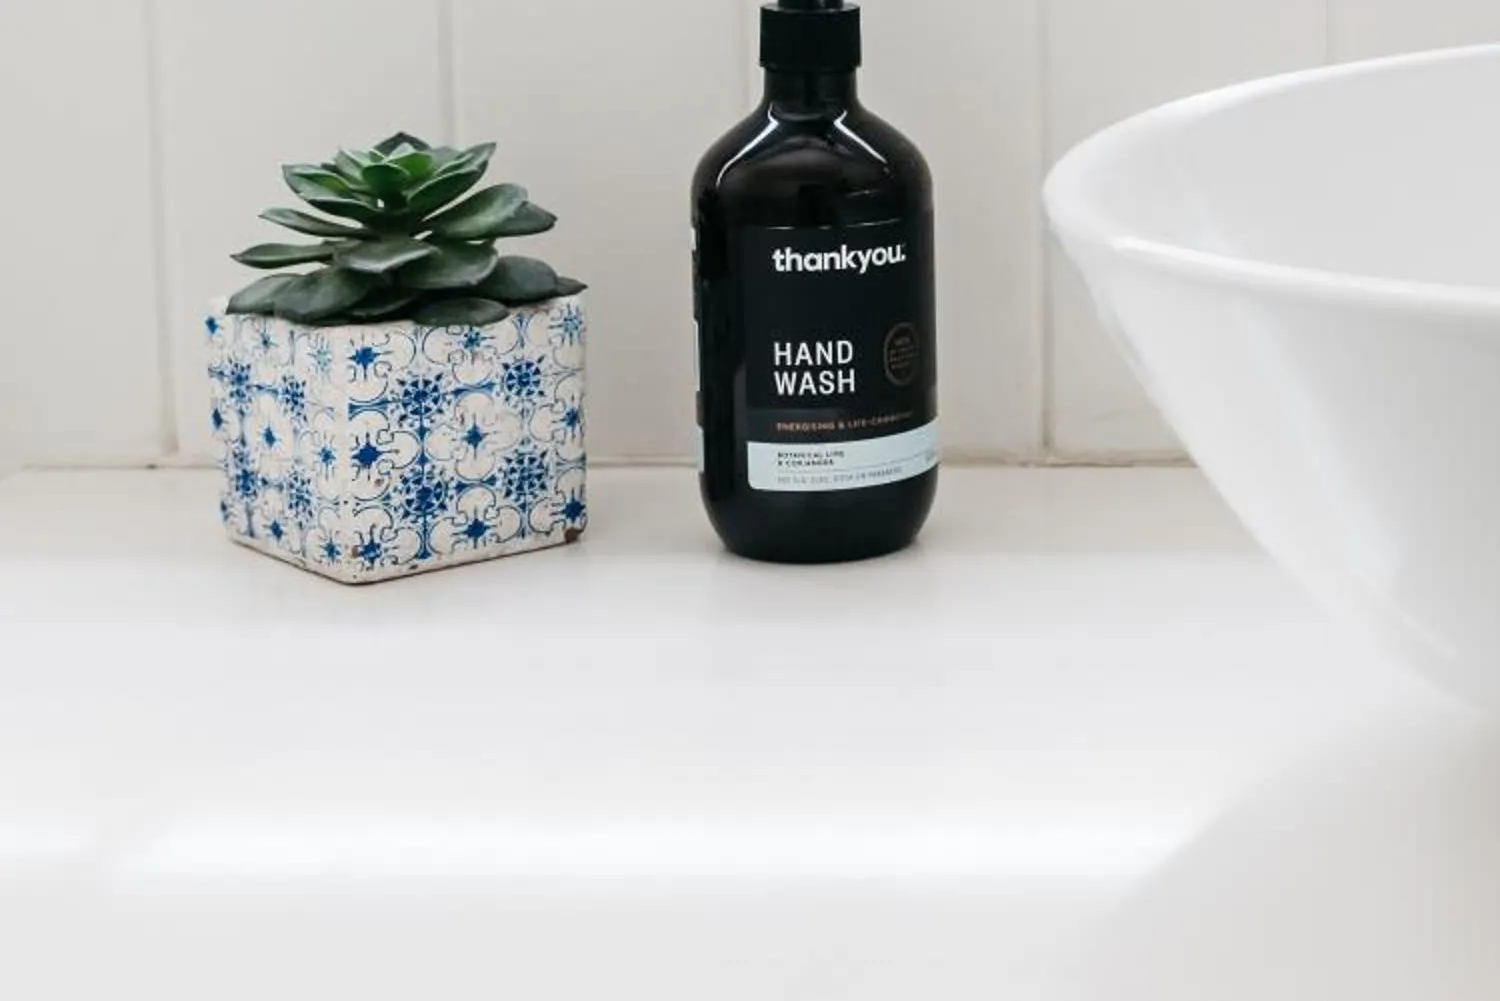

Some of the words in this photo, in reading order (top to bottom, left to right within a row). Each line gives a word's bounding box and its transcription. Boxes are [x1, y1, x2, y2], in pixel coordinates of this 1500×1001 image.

[772, 244, 906, 274] thankyou.
[773, 339, 853, 366] HAND
[773, 368, 856, 396] WASH
